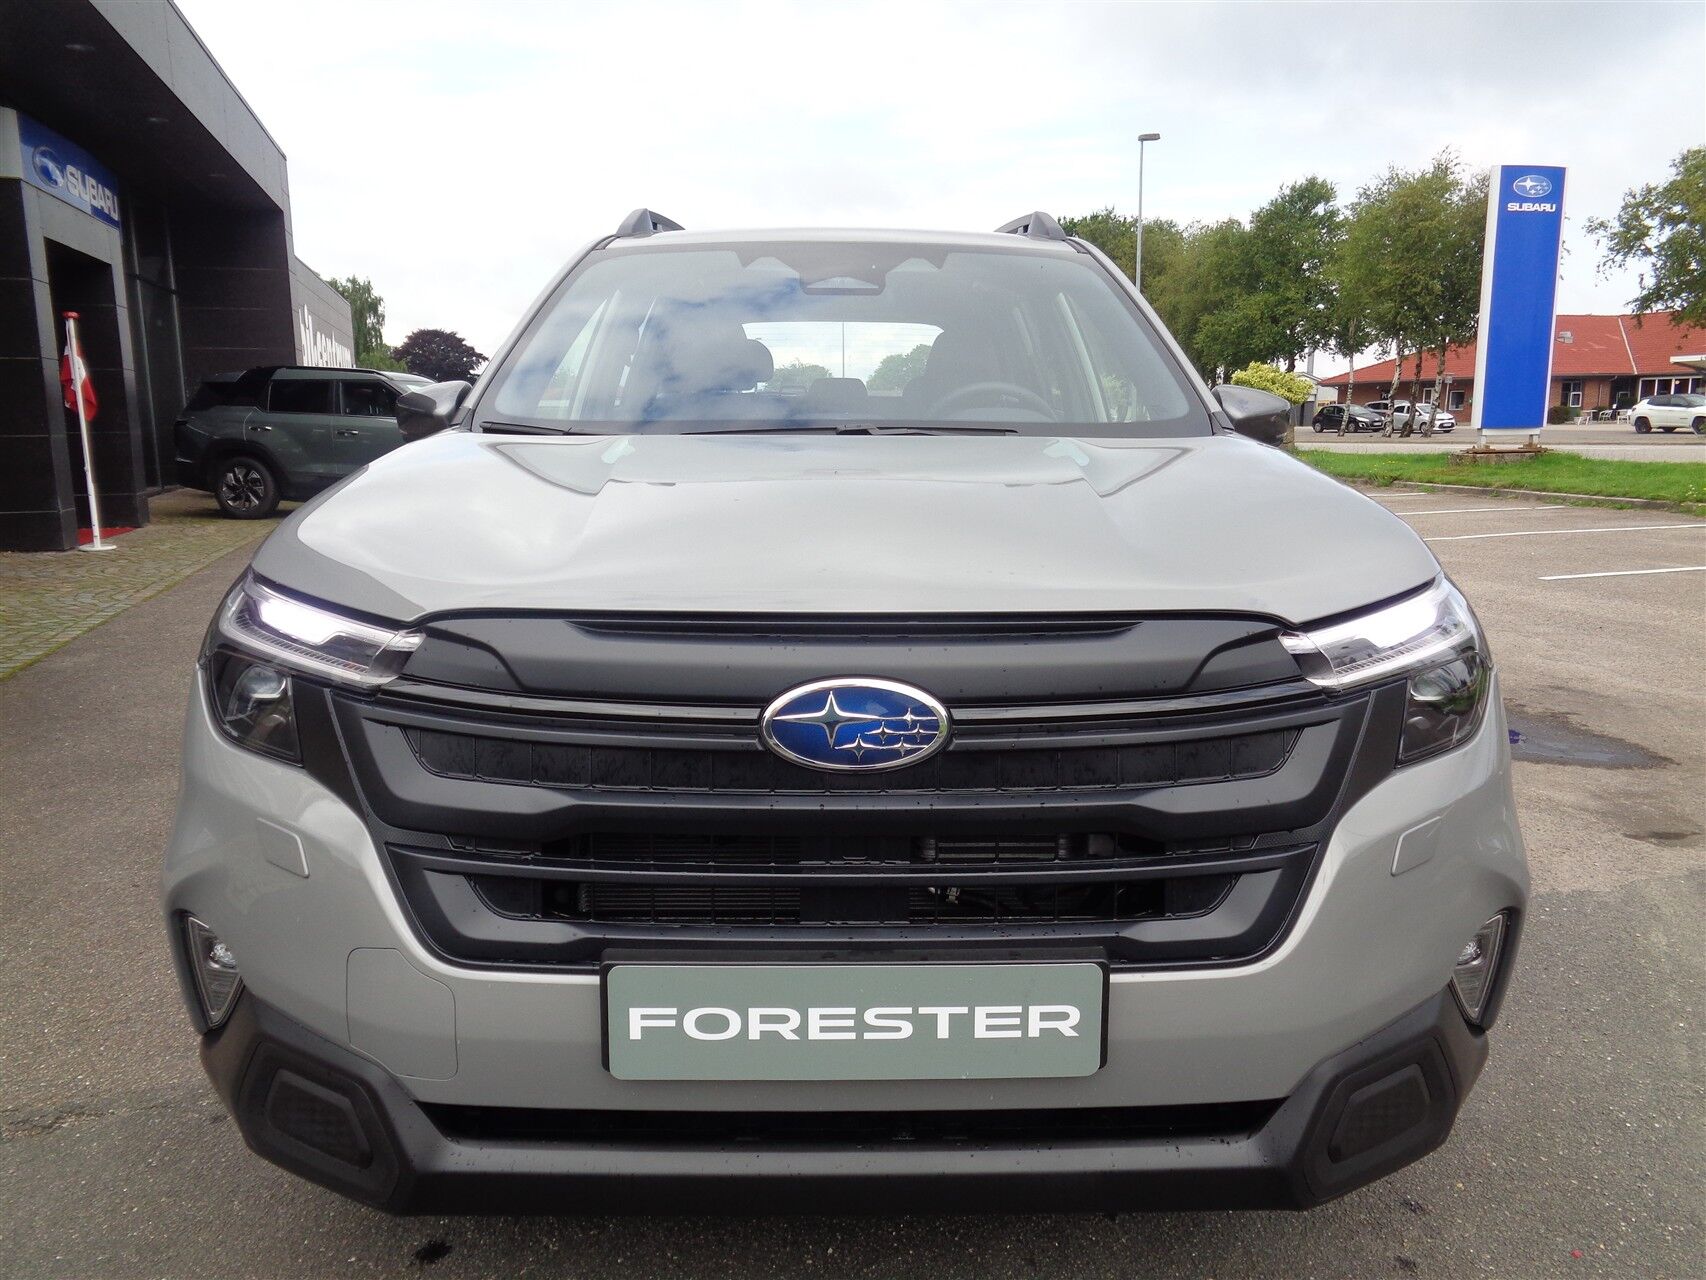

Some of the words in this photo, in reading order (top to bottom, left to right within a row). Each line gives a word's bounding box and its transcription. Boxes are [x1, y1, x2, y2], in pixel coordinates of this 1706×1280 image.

[66, 164, 119, 220] SUBARU
[1507, 202, 1557, 213] SUBARU
[628, 1004, 1082, 1041] FORESTER
